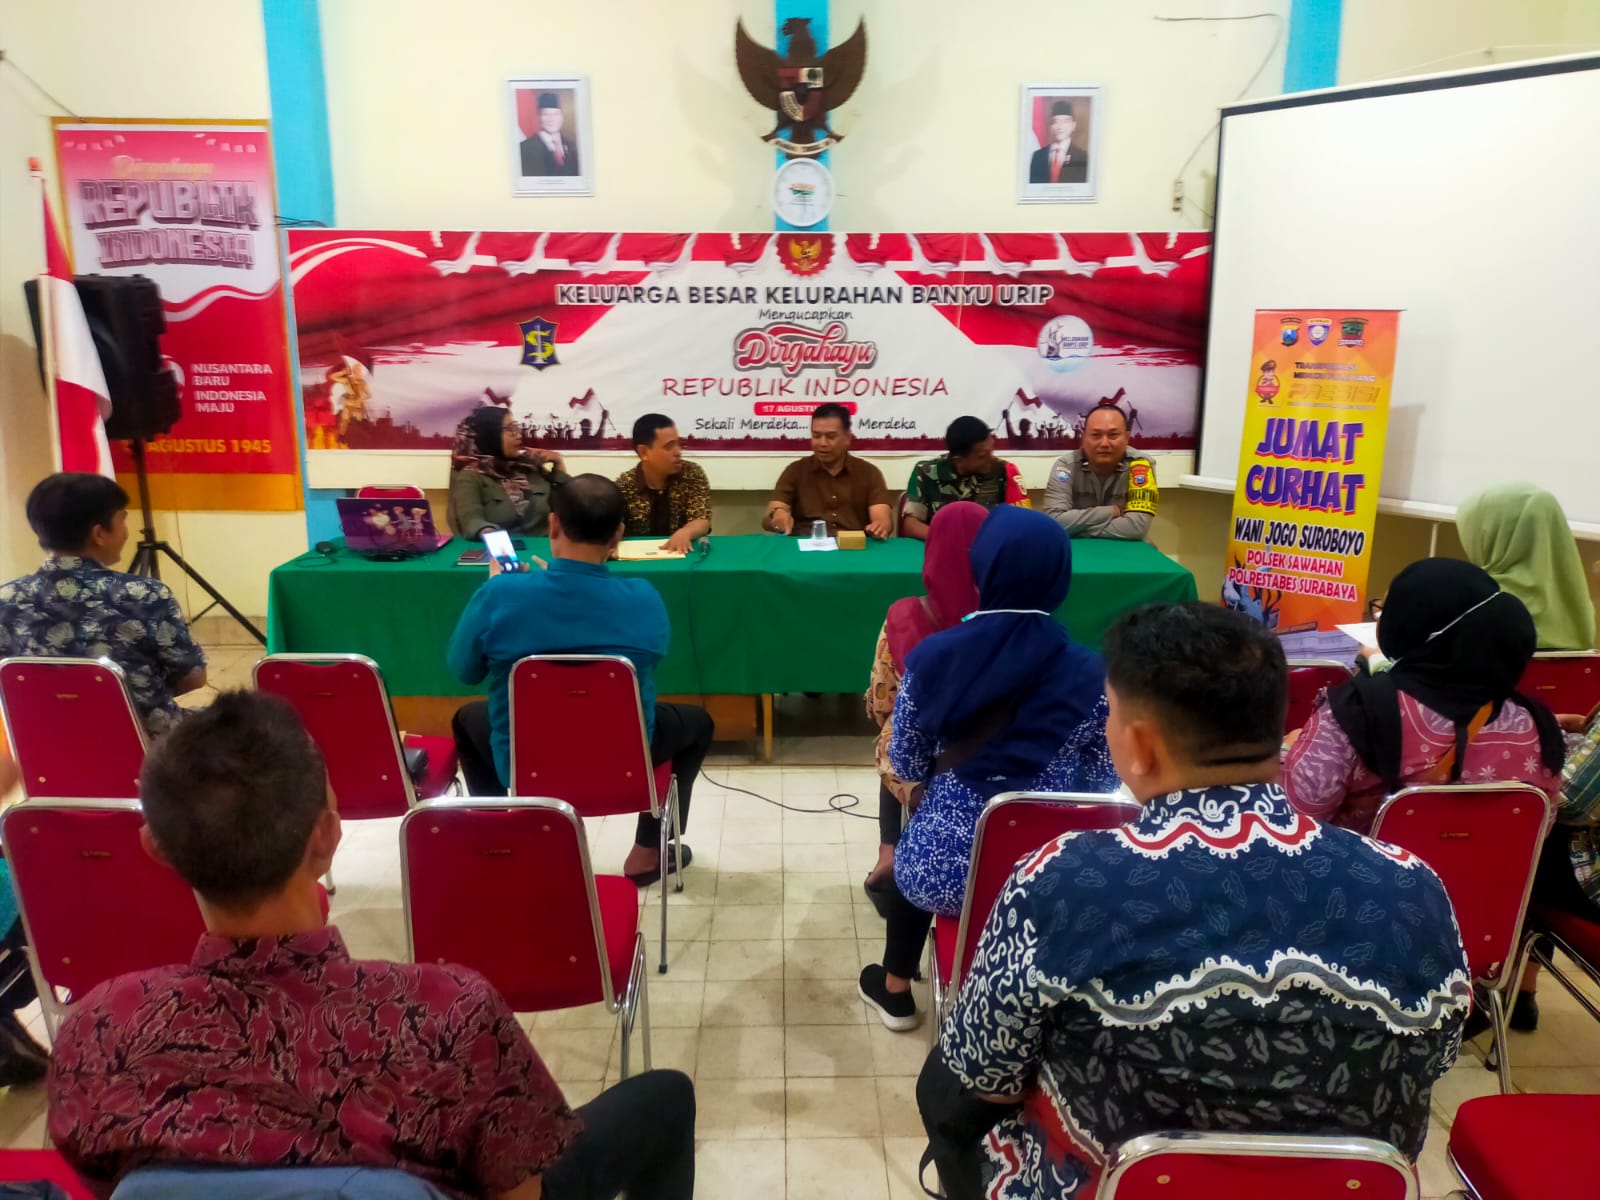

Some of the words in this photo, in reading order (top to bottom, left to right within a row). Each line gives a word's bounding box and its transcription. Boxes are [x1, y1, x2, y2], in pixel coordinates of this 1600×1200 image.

[79, 179, 260, 230] REPUBLIK
[96, 228, 255, 269] INDONESIA
[557, 285, 681, 305] KELUARGA
[689, 286, 758, 305] BESAR
[766, 286, 903, 304] KELURAHAN
[911, 285, 993, 305] BANYU
[998, 285, 1054, 305] URIP
[758, 308, 853, 323] Mengucapkan
[735, 323, 876, 376] Dirgahayu
[191, 363, 273, 375] NUSANTARA
[193, 375, 231, 387] BARU
[662, 377, 796, 397] REPUBLIK
[804, 376, 949, 397] INDONESIA
[194, 390, 268, 402] INDONESIA
[195, 402, 236, 413] MAJU
[761, 404, 775, 414] 17
[695, 417, 735, 430] Sekali
[858, 417, 917, 430] Merdeka
[148, 438, 226, 454] AGUSTUS
[232, 439, 273, 454] 1945
[1255, 417, 1365, 466] JUMAT
[1245, 464, 1366, 516] CURHAT
[1234, 516, 1265, 542] WANI
[1265, 520, 1298, 549] JOGO
[1299, 524, 1366, 557] SUROBOYO
[1246, 549, 1286, 570] POLSEK
[1287, 557, 1344, 578] SAWAHAN
[1229, 567, 1298, 593] POLRESTABES
[1299, 577, 1358, 602] SURABAYA
